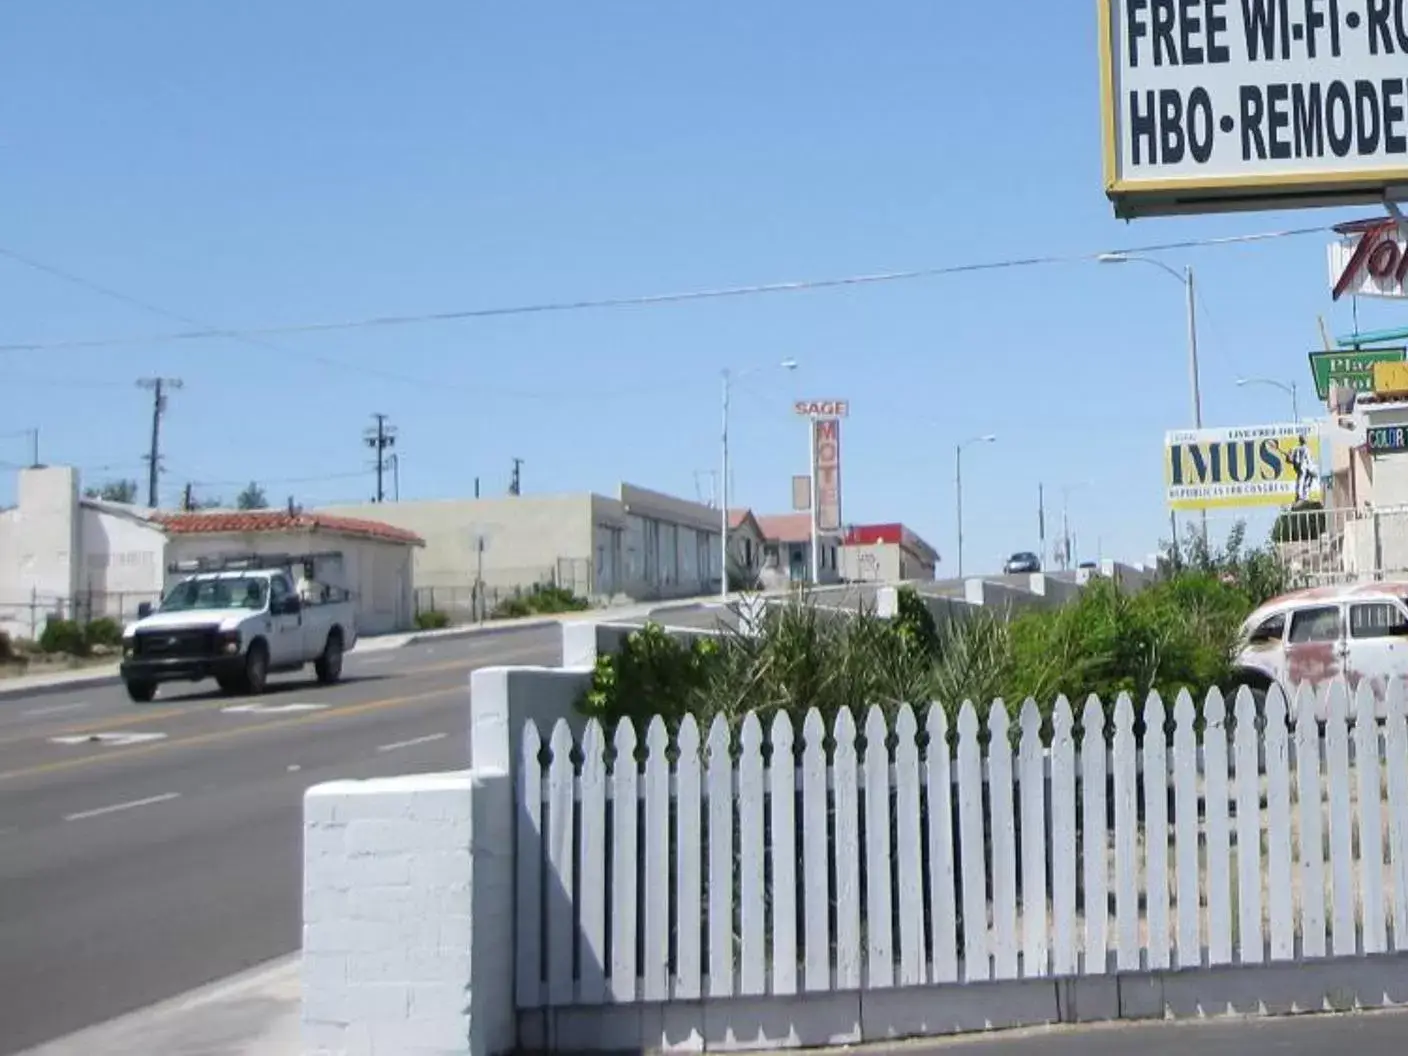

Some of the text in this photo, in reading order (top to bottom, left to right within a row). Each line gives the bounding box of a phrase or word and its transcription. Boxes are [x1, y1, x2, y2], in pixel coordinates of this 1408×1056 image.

[1128, 86, 1214, 166] HBO
[1330, 359, 1375, 373] Plaz
[795, 401, 846, 415] SAGE
[1367, 428, 1405, 449] COLOR
[819, 421, 839, 520] MOTE
[1170, 438, 1283, 485] IMUS
